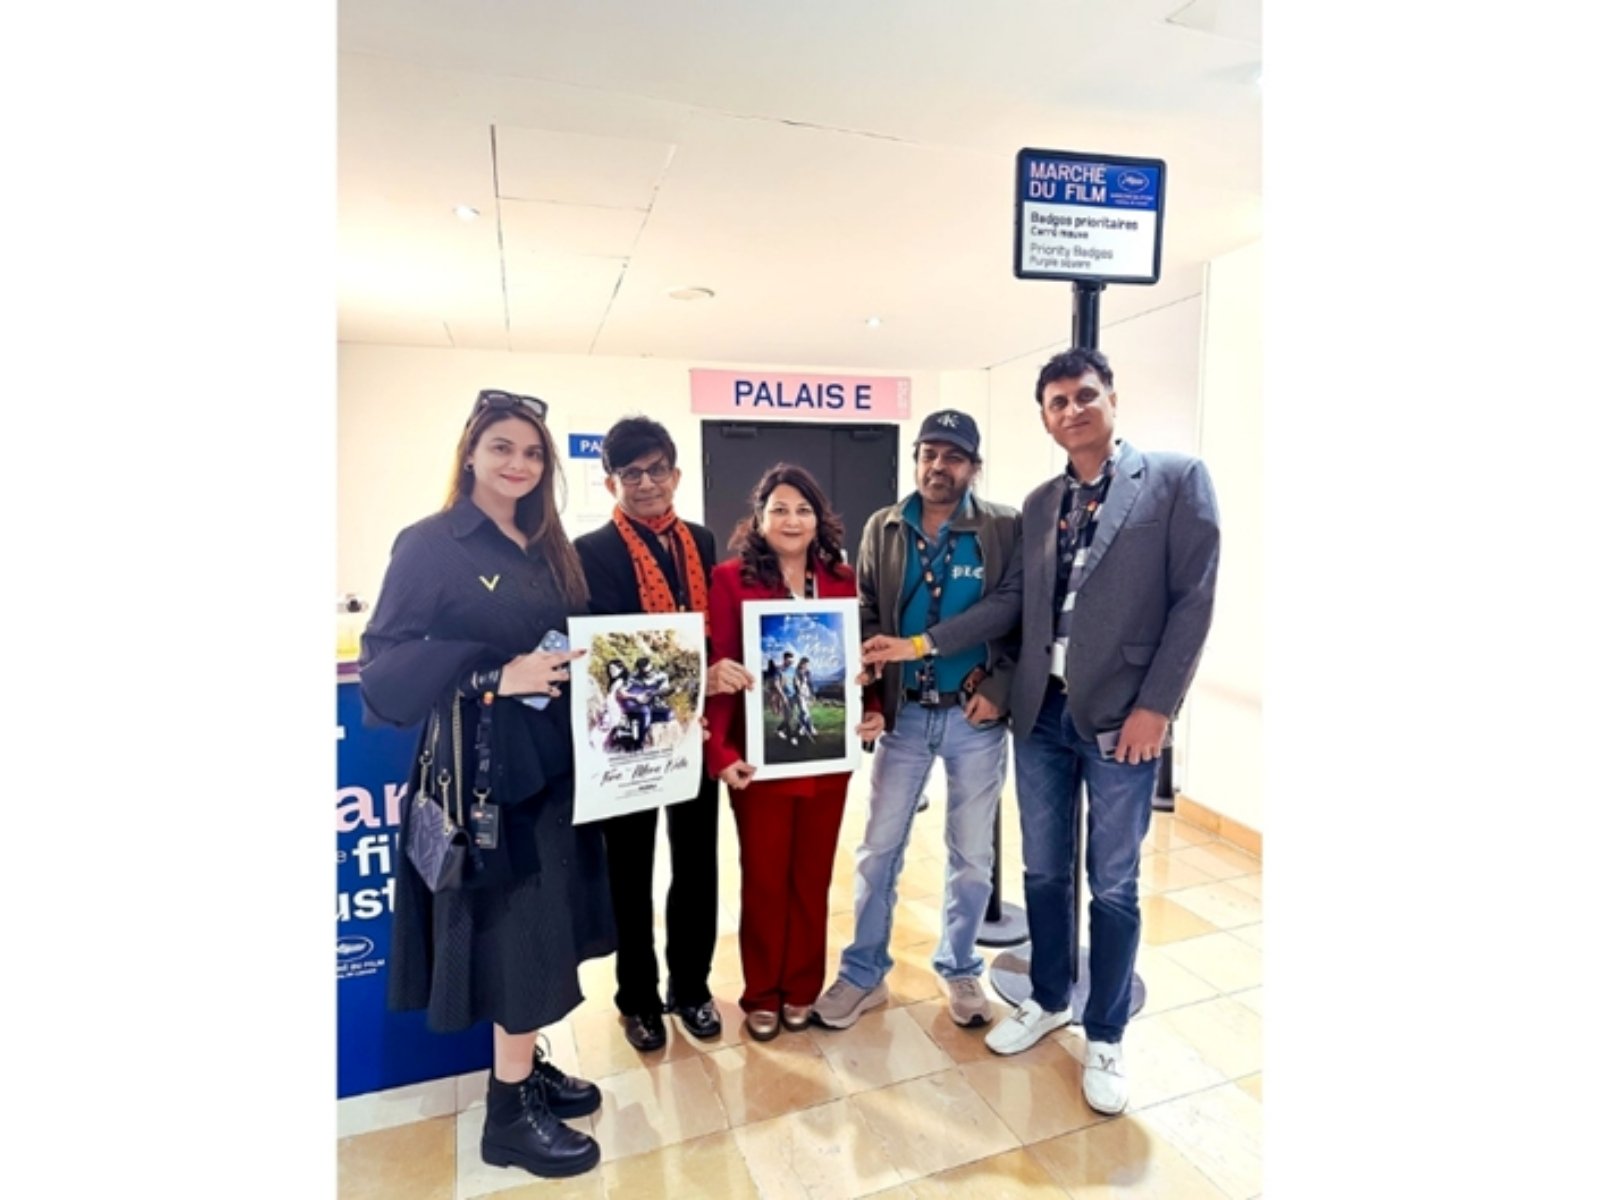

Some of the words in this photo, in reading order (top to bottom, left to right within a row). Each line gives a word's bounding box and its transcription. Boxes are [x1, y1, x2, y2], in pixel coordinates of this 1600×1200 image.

[1029, 180, 1056, 198] DU
[1065, 183, 1106, 203] FILM
[1031, 211, 1073, 227] Badges
[1074, 215, 1138, 231] prioritaires
[1030, 242, 1071, 258] Priority
[1073, 244, 1113, 261] Badges
[1030, 255, 1058, 269] Purple
[734, 380, 845, 409] PALAIS
[855, 384, 872, 410] E
